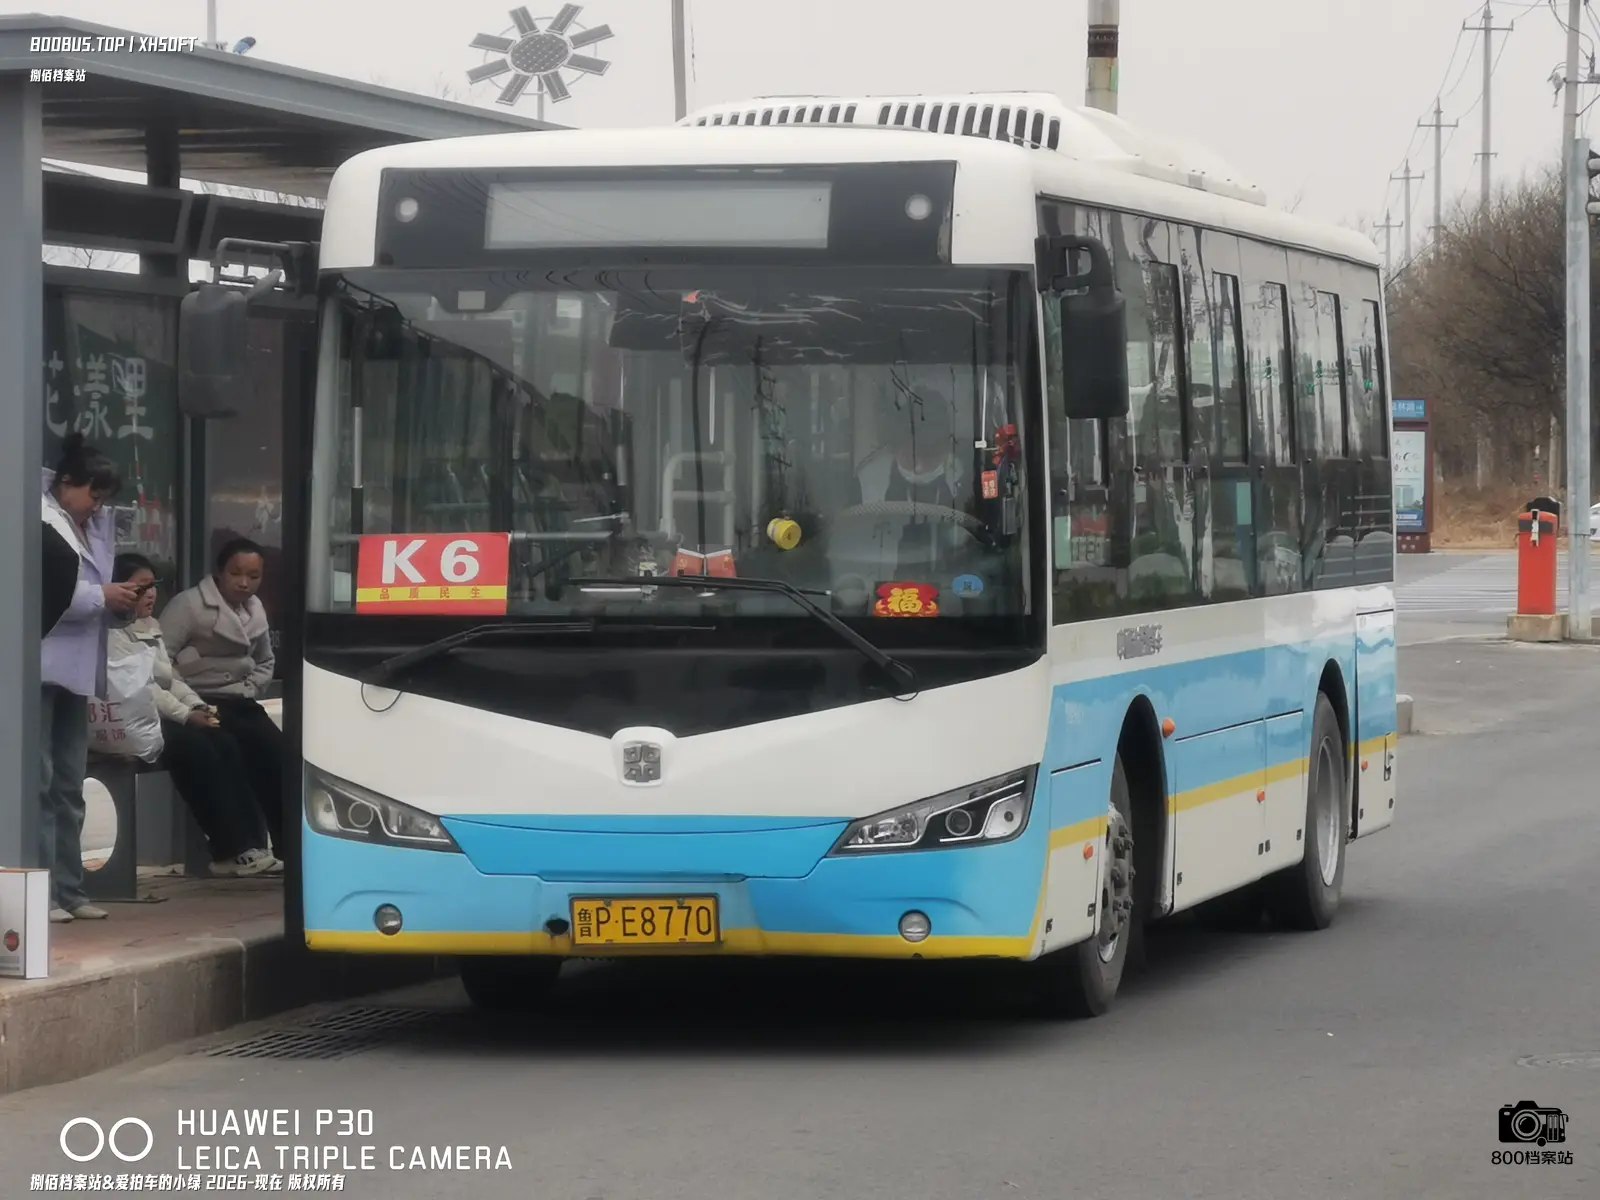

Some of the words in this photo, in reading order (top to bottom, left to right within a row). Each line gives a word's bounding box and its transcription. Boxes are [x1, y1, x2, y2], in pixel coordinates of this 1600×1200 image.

[381, 539, 427, 584] K
[440, 539, 480, 583] 6
[887, 587, 923, 613] 福
